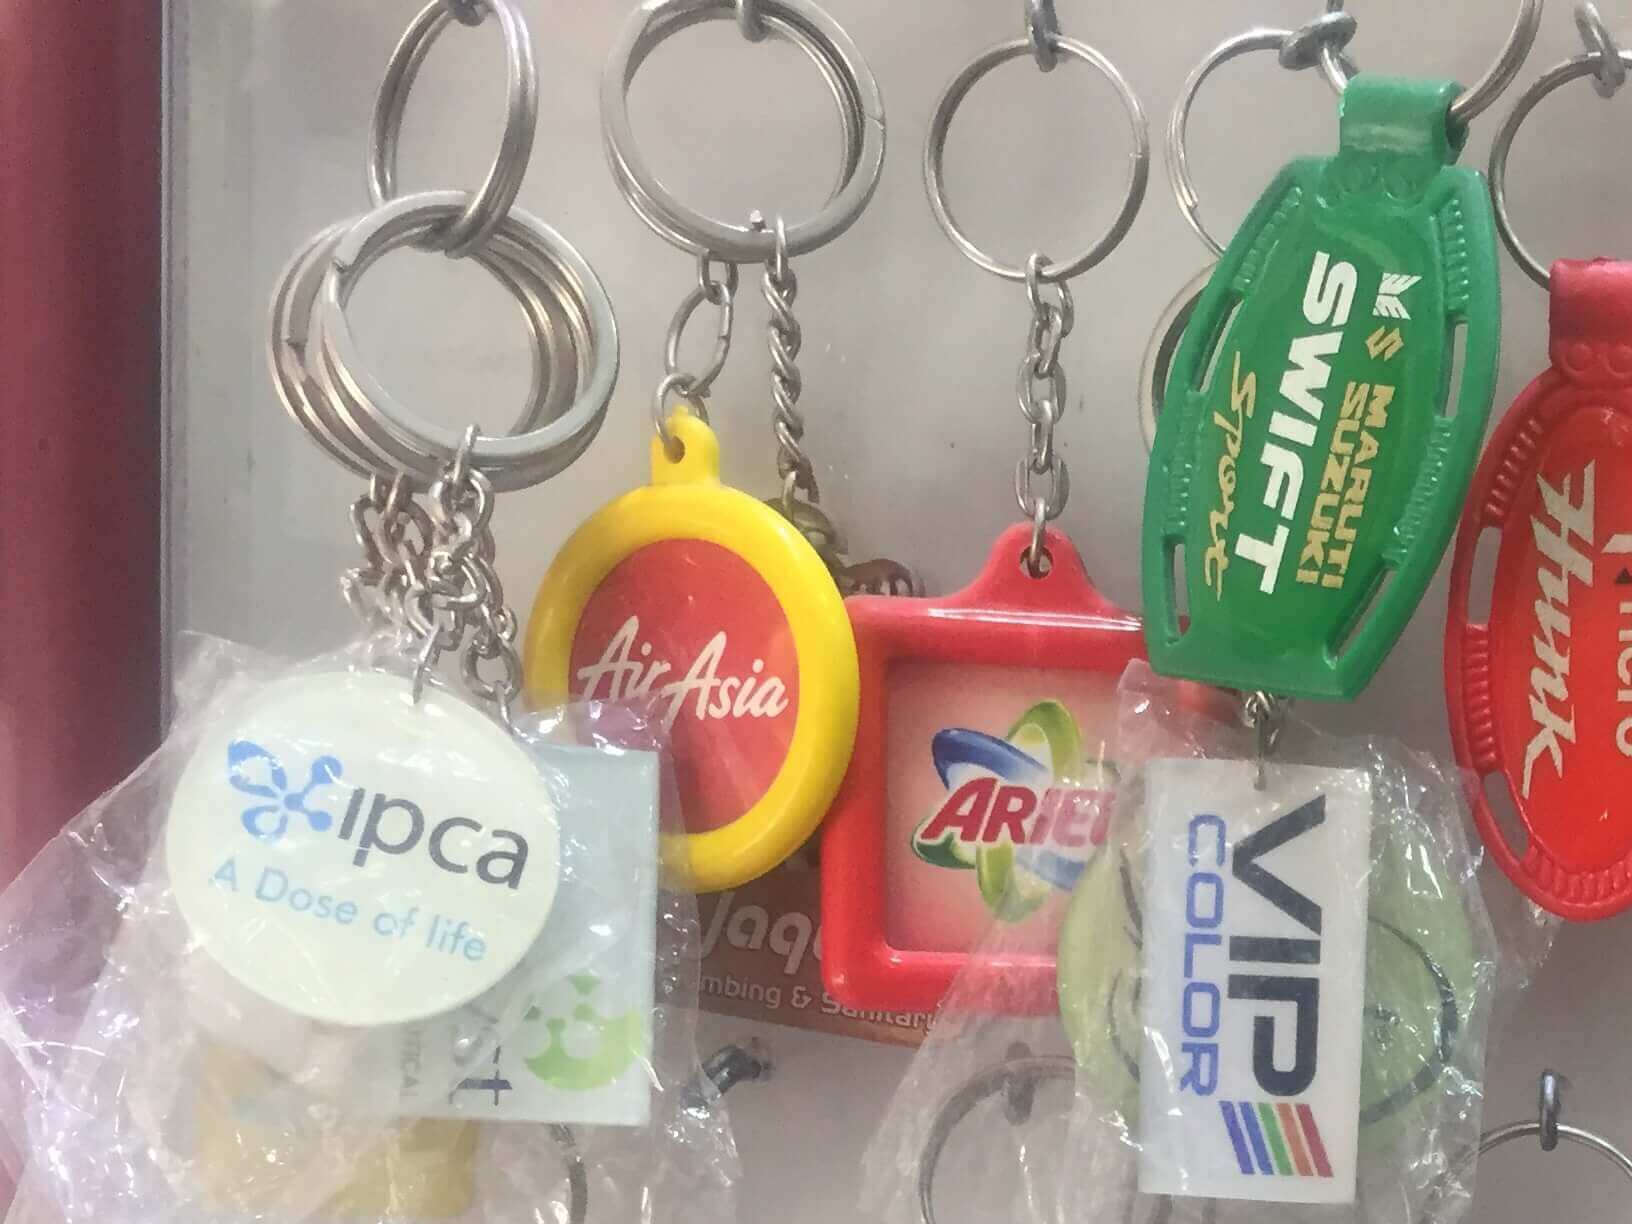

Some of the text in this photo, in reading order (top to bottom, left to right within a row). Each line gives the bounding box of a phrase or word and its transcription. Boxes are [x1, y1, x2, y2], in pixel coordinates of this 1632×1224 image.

[1205, 351, 1257, 601] Sport
[1234, 251, 1358, 594] SWIFT
[1296, 381, 1370, 584] SUZUKI
[1321, 384, 1395, 589] MARUTI
[1522, 459, 1596, 799] Hunk
[207, 856, 487, 963] A Dose of life
[336, 785, 530, 890] ipca
[690, 890, 823, 974] Jaq
[1228, 794, 1326, 1097] VIP
[1179, 814, 1227, 1097] COLOR
